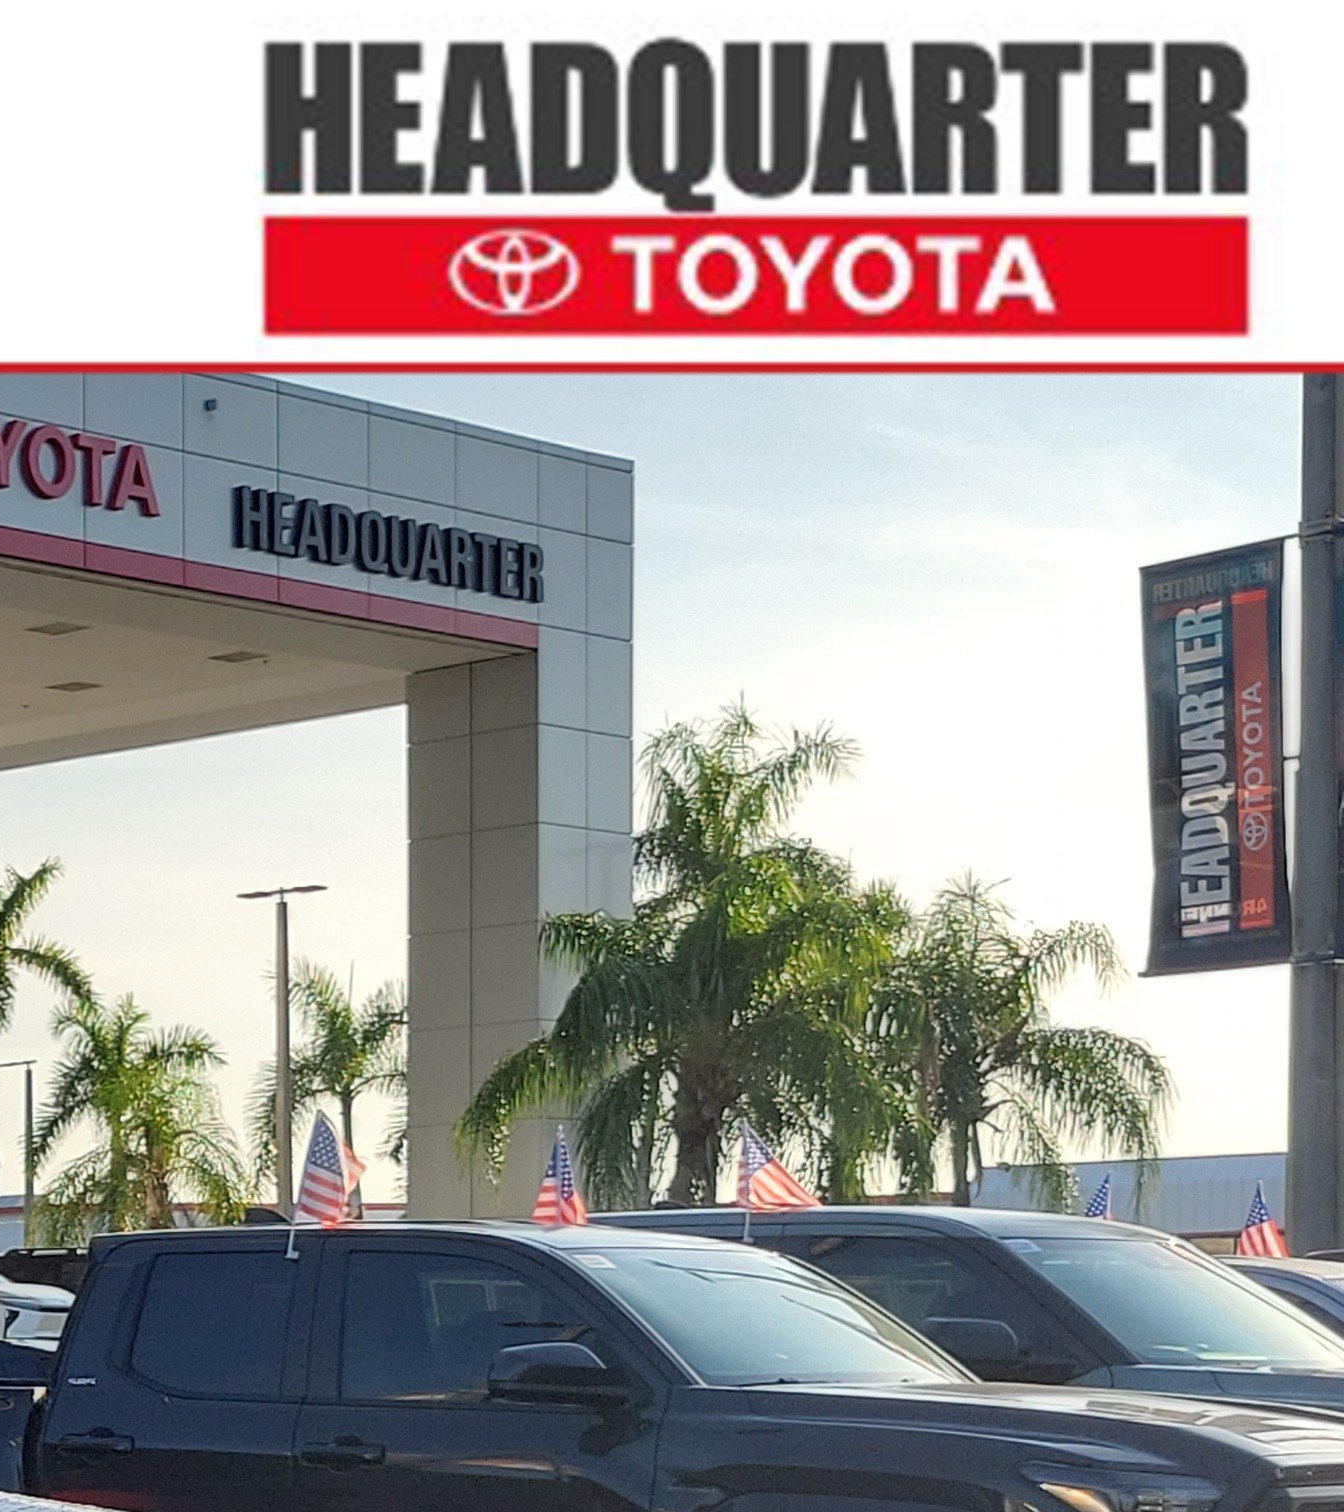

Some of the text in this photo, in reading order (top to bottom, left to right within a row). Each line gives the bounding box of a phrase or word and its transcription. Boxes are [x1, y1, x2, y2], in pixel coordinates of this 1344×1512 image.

[231, 485, 544, 602] HEADQUARTER
[1174, 599, 1236, 938] HEADQUARTER
[1241, 680, 1265, 808] TOYOTA
